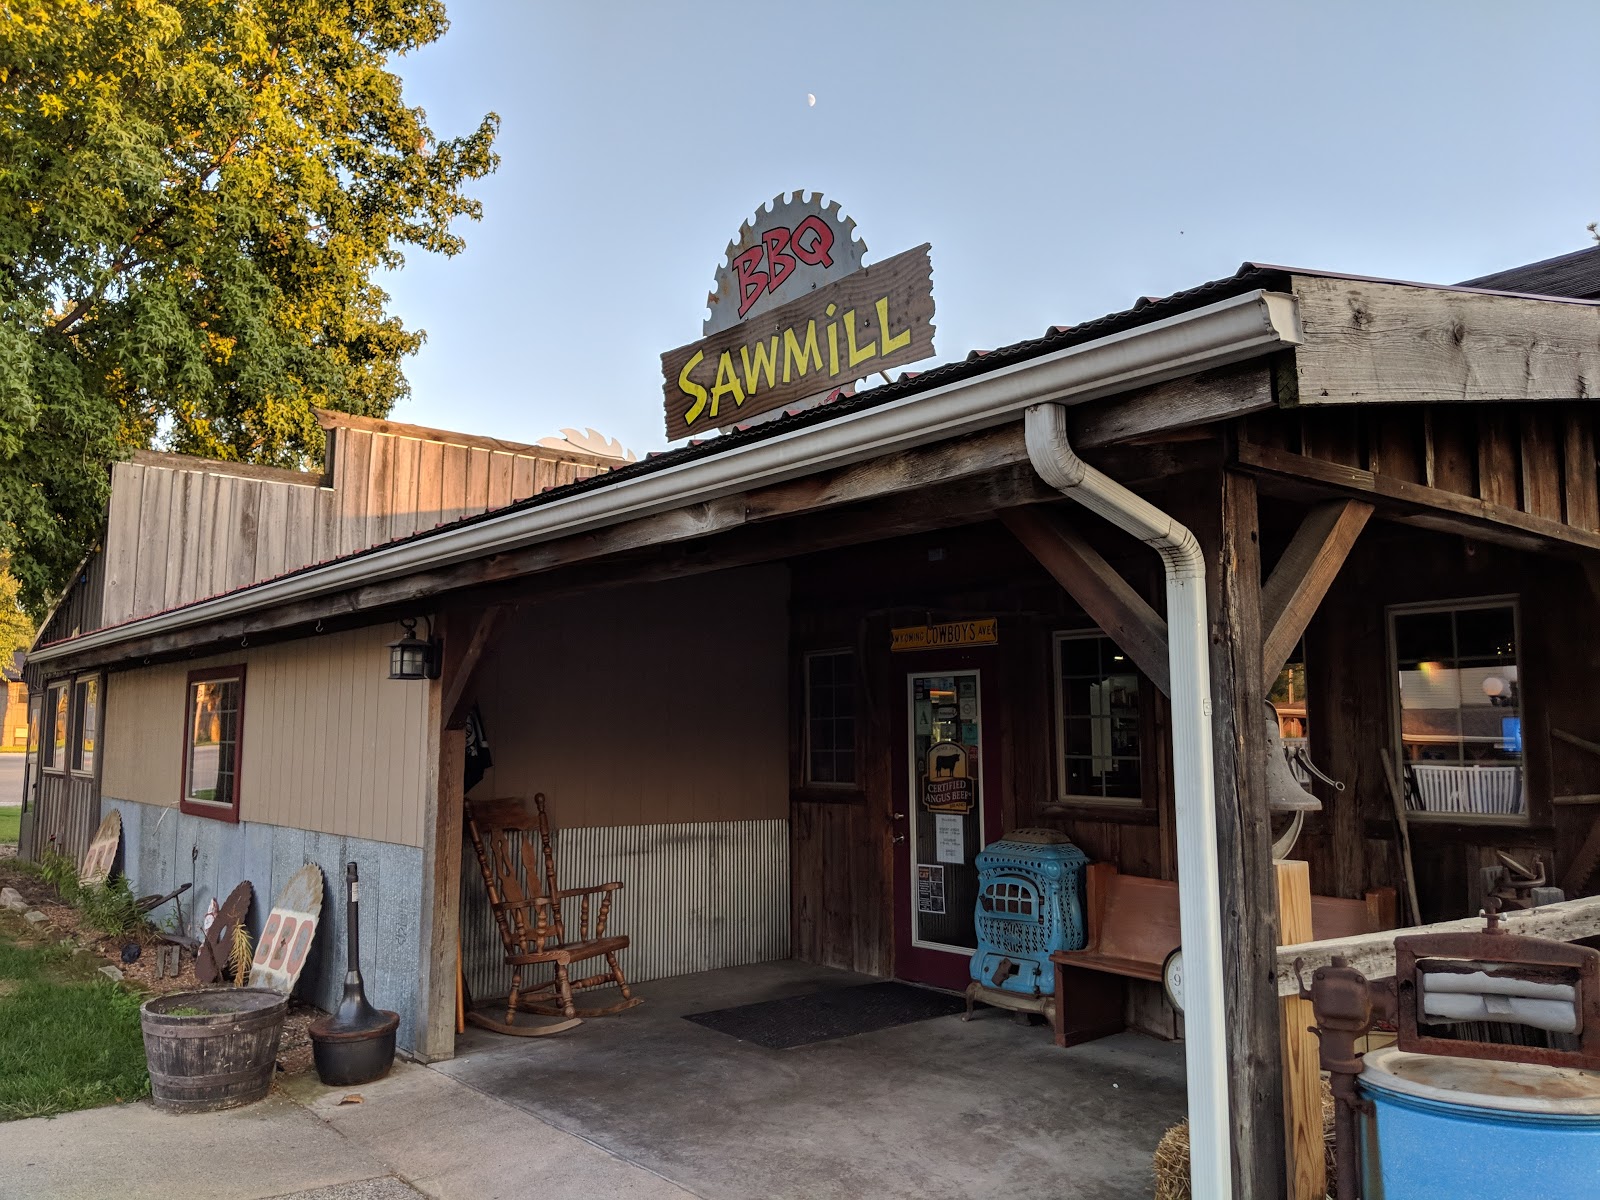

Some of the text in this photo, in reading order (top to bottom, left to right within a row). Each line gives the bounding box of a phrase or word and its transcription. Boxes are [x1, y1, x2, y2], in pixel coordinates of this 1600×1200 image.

[732, 214, 834, 319] BBQ
[926, 623, 975, 644] COWBOYS
[979, 625, 991, 636] AVE
[927, 780, 966, 792] CERTIFIED
[925, 792, 951, 803] ANGUS
[1174, 974, 1181, 987] 9
